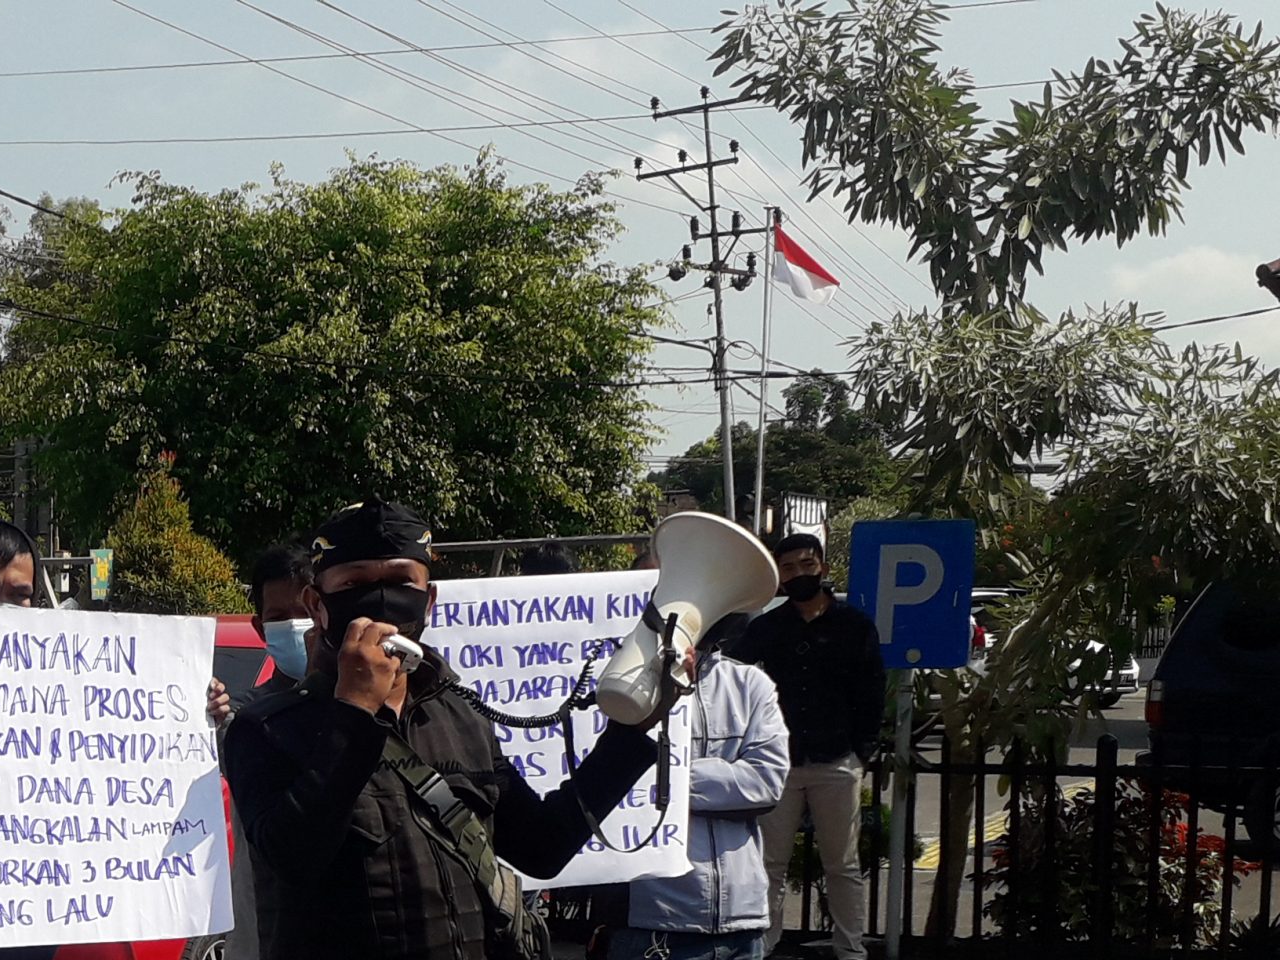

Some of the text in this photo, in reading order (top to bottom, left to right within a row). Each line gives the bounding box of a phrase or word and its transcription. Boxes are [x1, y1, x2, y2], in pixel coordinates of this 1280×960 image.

[875, 544, 944, 644] P
[459, 644, 503, 669] OKI
[513, 641, 573, 669] YANG
[84, 684, 189, 723] PROSES
[69, 730, 219, 763] PENYIDIKAN
[18, 777, 95, 806] DANA
[105, 777, 175, 808] DESA
[131, 818, 206, 836] LAMPAM
[82, 861, 96, 883] 3
[105, 853, 196, 881] BULAN
[46, 894, 114, 925] LALU
